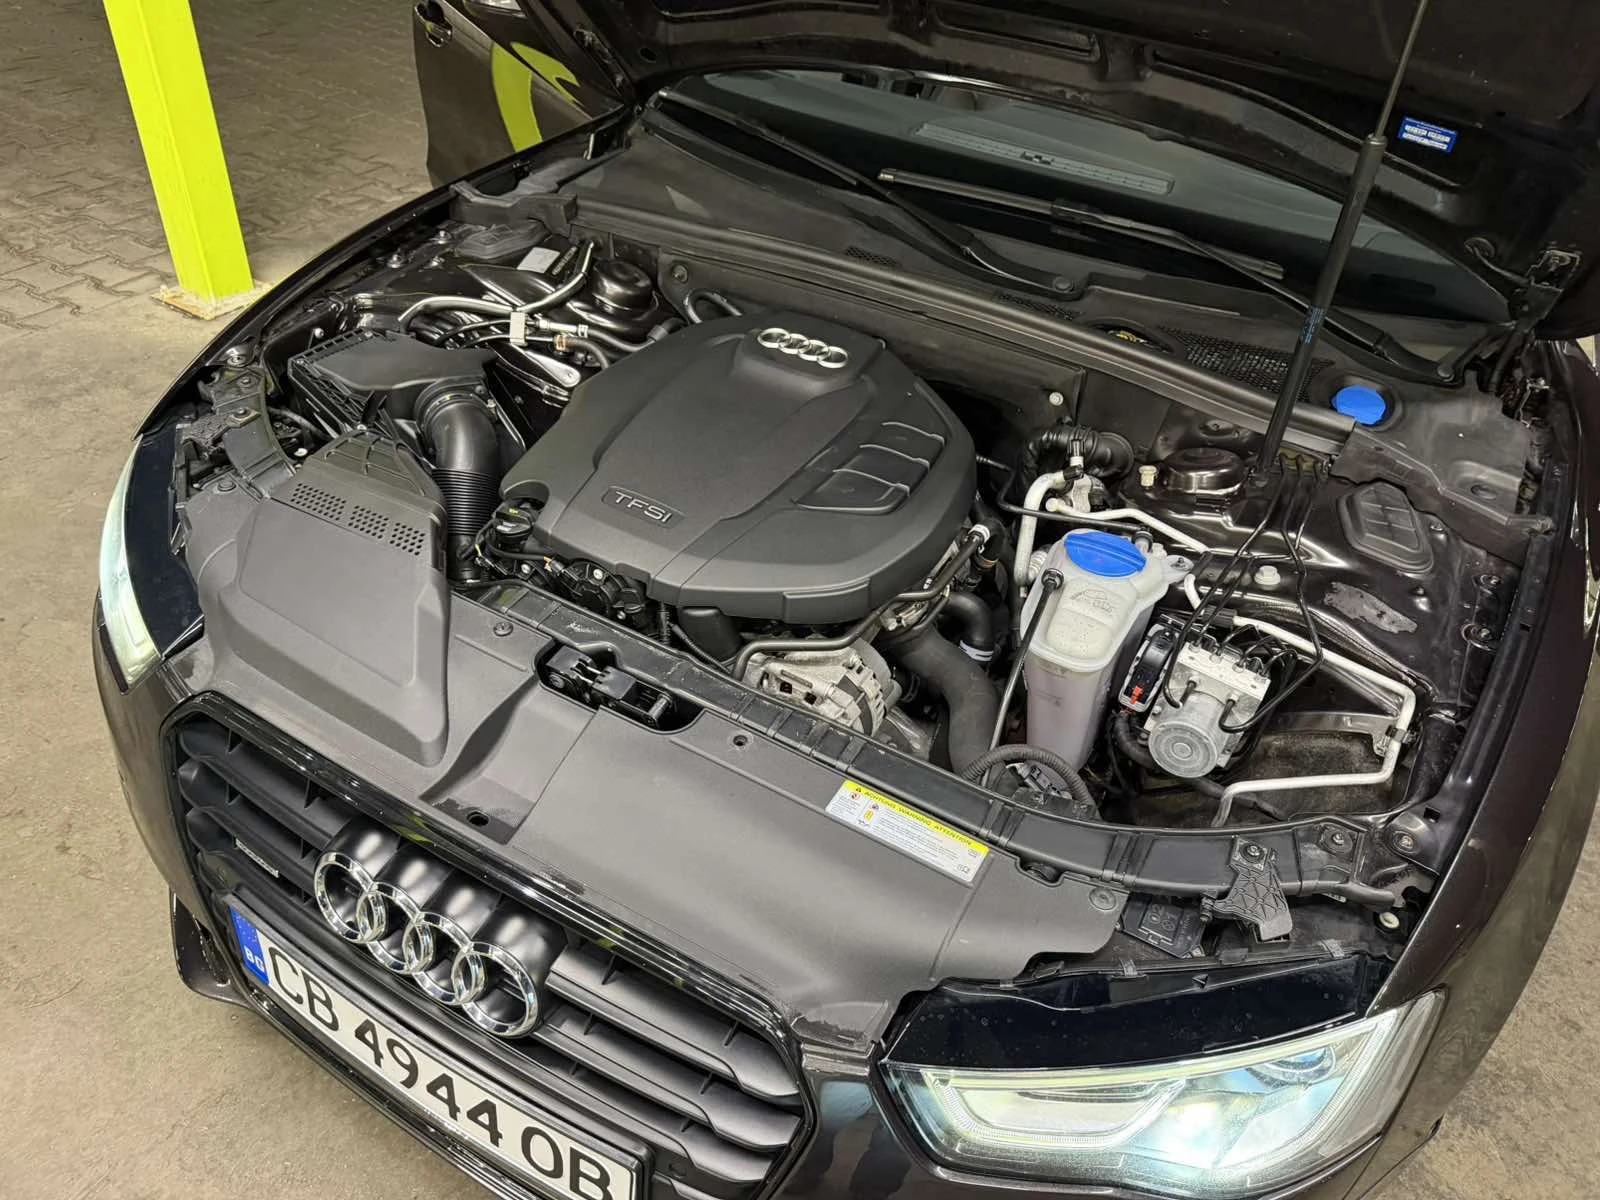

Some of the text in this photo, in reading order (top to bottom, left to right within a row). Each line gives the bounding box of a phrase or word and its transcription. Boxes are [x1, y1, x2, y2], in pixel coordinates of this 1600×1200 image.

[615, 490, 672, 523] TFSI
[864, 791, 897, 810] ACHTUNG
[898, 806, 933, 826] WARNING
[934, 824, 972, 846] ATTENTION
[243, 945, 266, 973] BG
[268, 945, 614, 1200] CB 4944 OB
